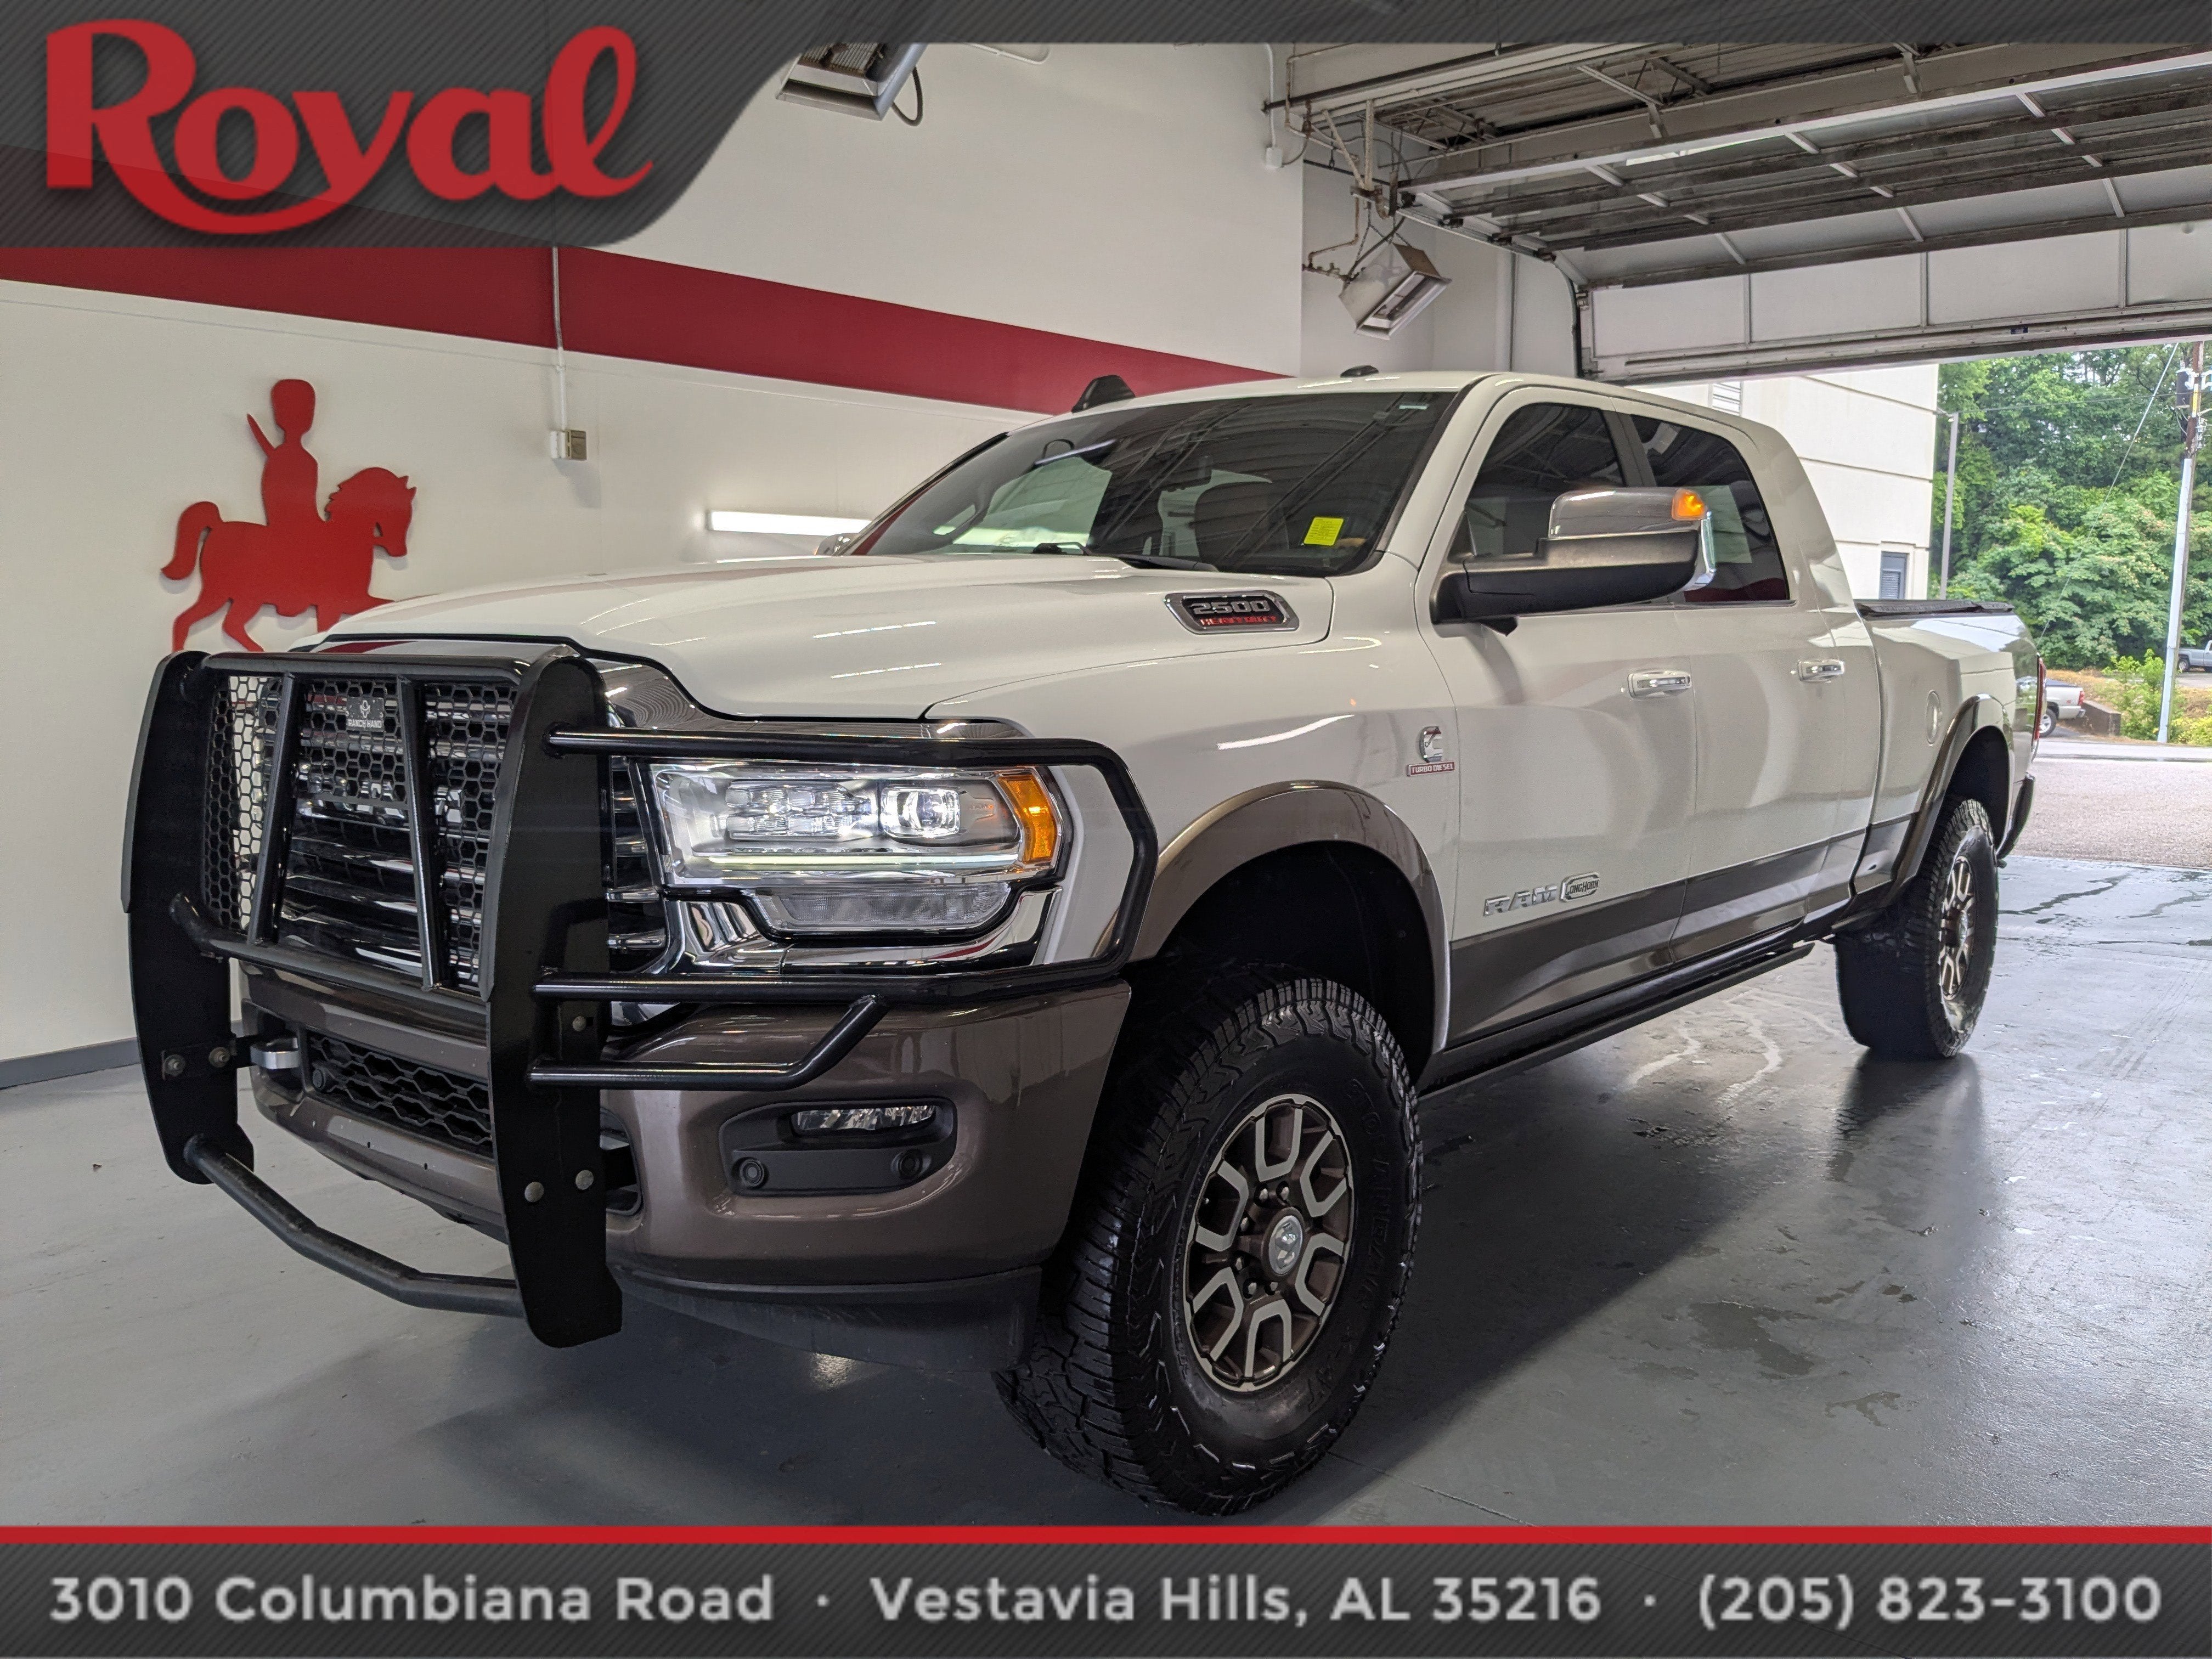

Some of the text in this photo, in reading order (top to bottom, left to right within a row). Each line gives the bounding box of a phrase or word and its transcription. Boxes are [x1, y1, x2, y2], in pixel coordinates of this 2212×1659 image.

[1189, 600, 1271, 615] 2500
[348, 719, 382, 729] RANCH HAND
[1412, 763, 1454, 774] TURBO DIESEL
[1483, 879, 1599, 917] RAM LONGHORN
